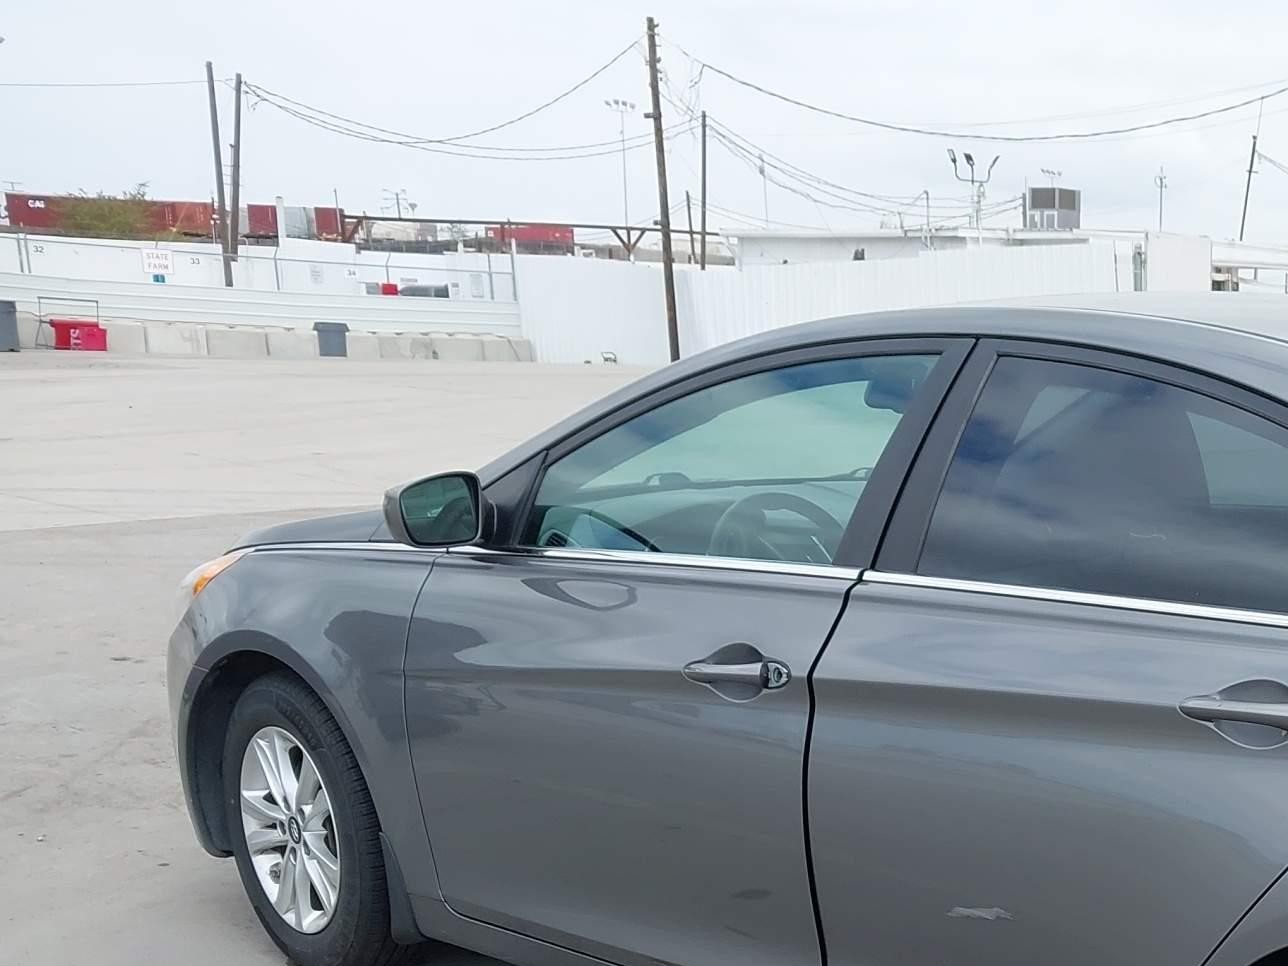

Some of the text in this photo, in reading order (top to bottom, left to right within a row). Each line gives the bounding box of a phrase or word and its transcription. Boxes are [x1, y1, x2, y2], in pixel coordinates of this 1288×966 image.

[33, 245, 45, 253] 32
[145, 252, 169, 261] STATE
[148, 262, 169, 271] FARM
